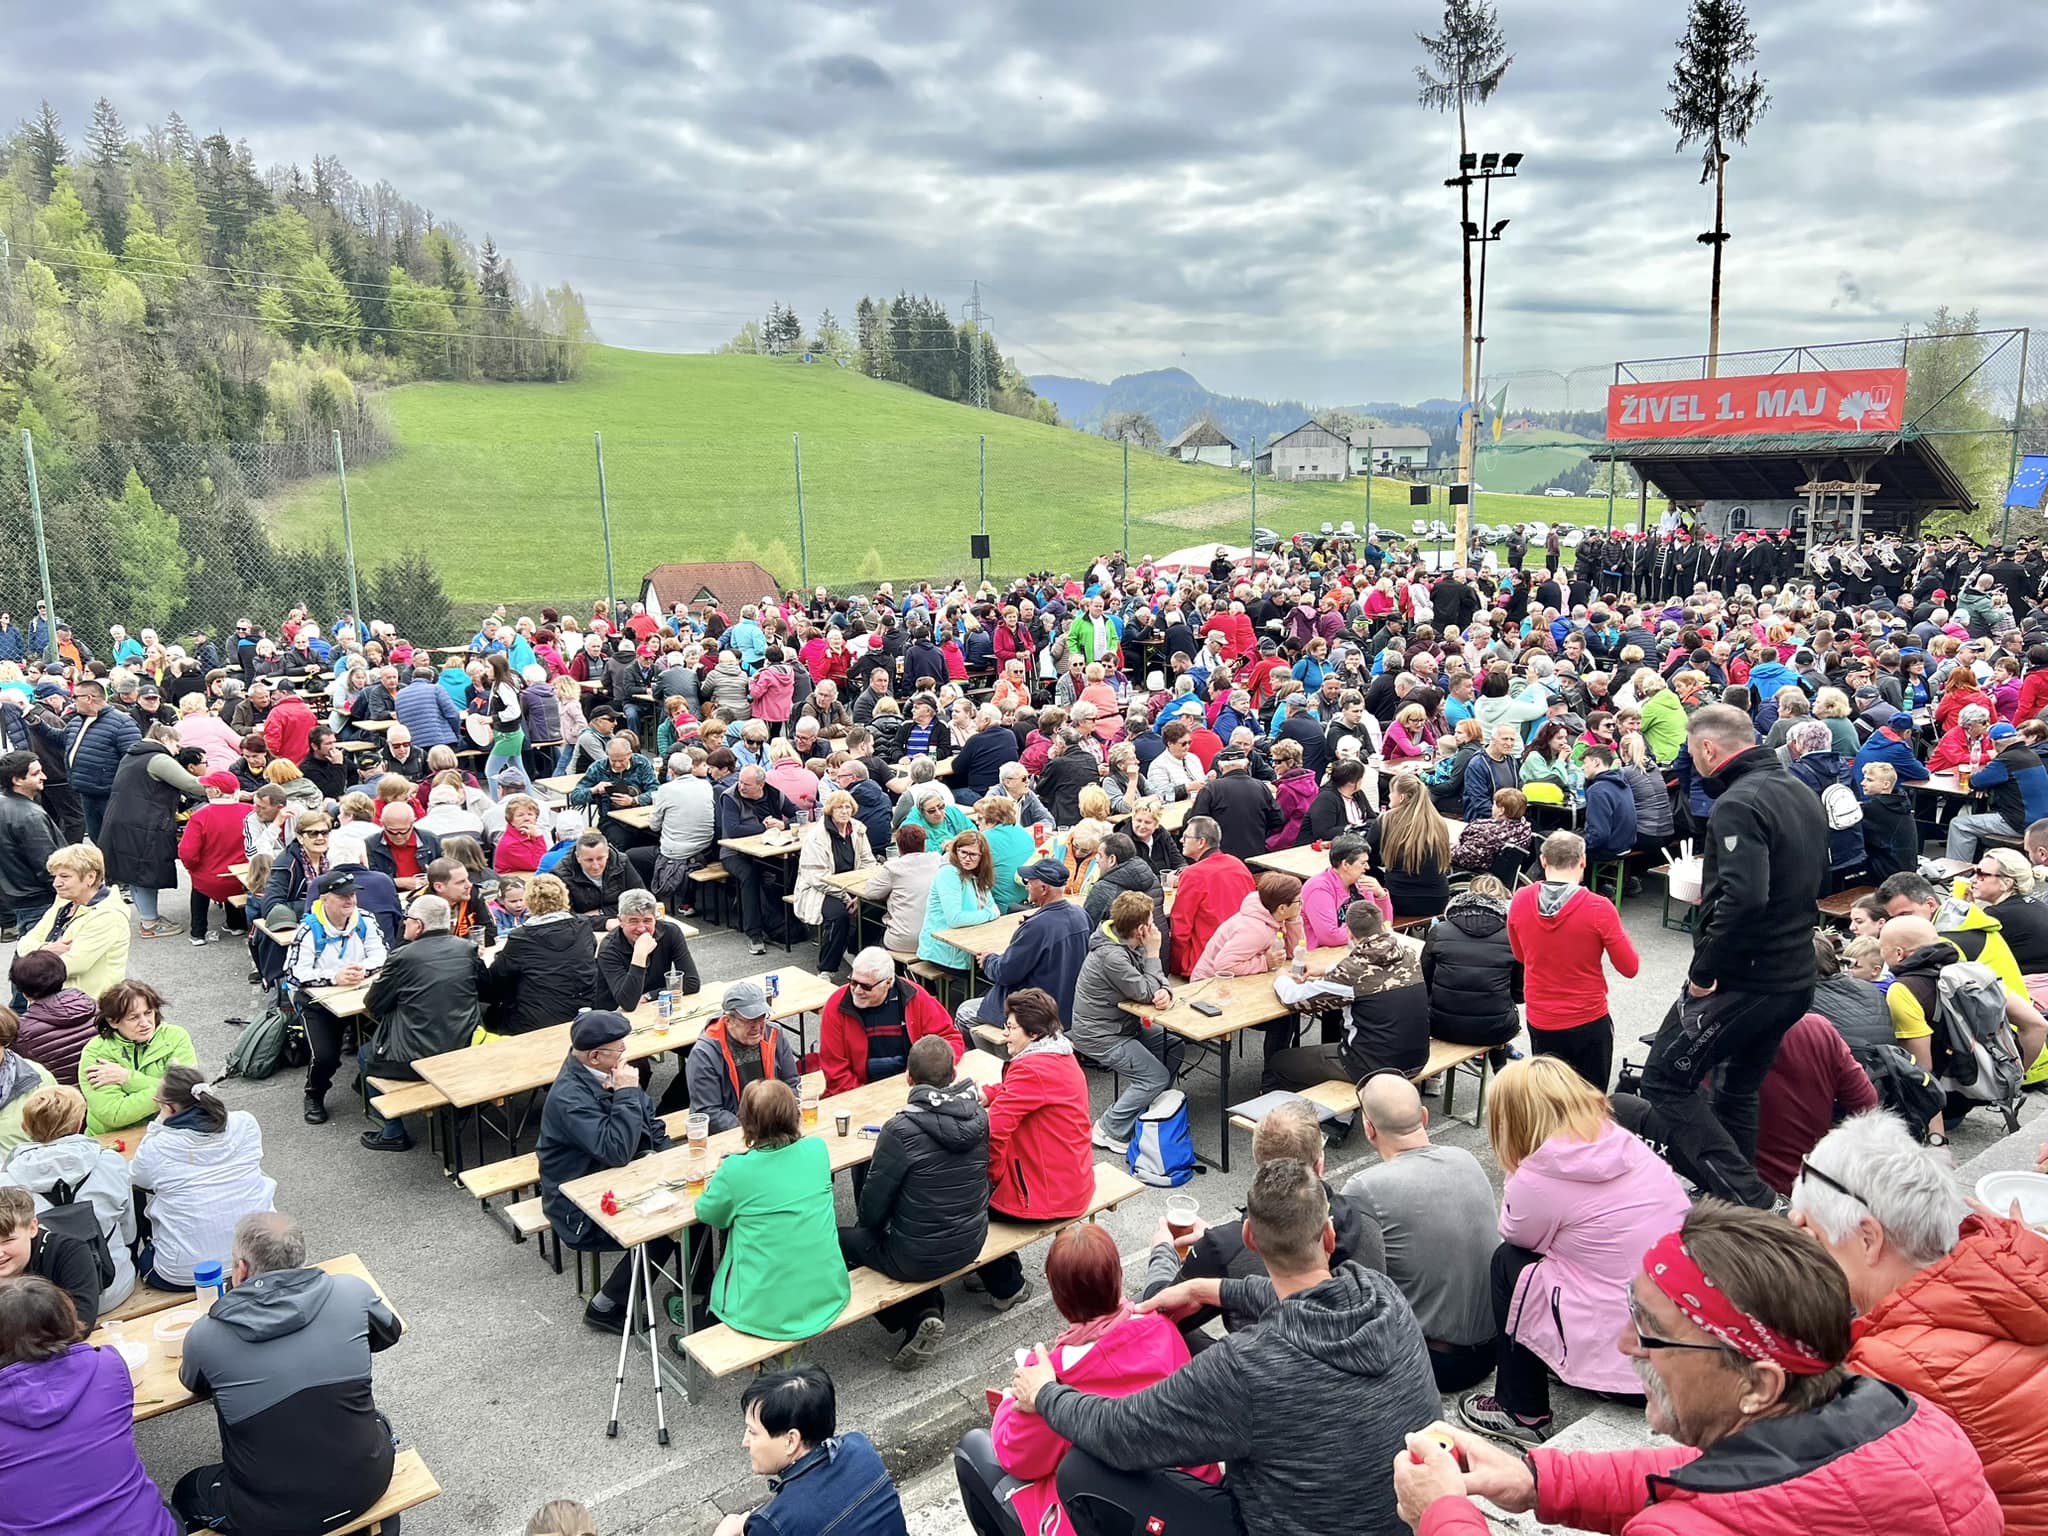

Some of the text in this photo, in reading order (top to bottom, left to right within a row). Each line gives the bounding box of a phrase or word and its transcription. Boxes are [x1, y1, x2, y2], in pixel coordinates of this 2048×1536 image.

[1620, 387, 1827, 424] ŽIVEL 1. MAJ
